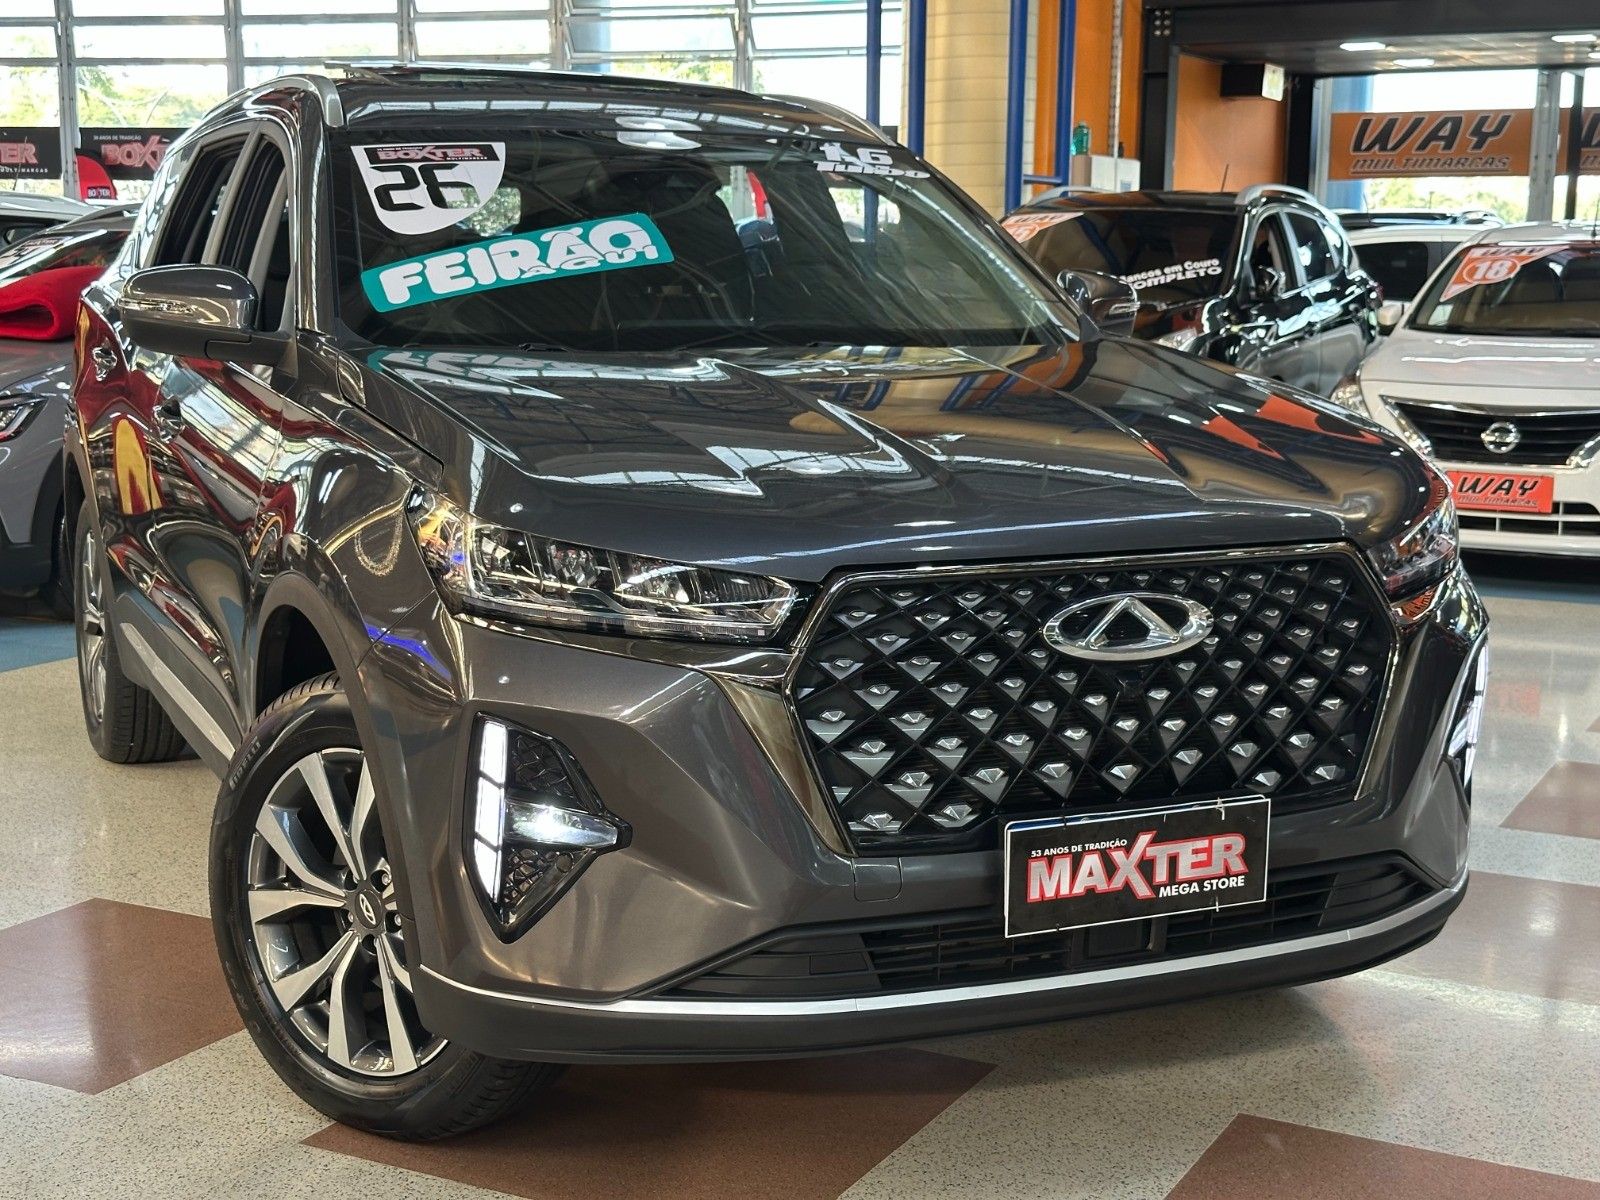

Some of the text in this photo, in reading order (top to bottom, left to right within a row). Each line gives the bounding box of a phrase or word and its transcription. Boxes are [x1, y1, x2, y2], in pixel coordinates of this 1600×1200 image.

[1352, 114, 1513, 153] WAY
[377, 146, 484, 161] BOXTER
[1352, 156, 1510, 171] MULTIMARCAS
[369, 163, 481, 211] 26
[379, 220, 652, 304] FEIRÃO
[1163, 264, 1183, 274] em
[1183, 258, 1220, 270] Couro
[1473, 260, 1511, 279] 18
[1457, 475, 1540, 497] WAY
[1031, 838, 1128, 858] 53 ANOS DE TRADIÇÃO
[1027, 831, 1249, 903] MAXTER
[1158, 875, 1245, 898] MEGA STORE
